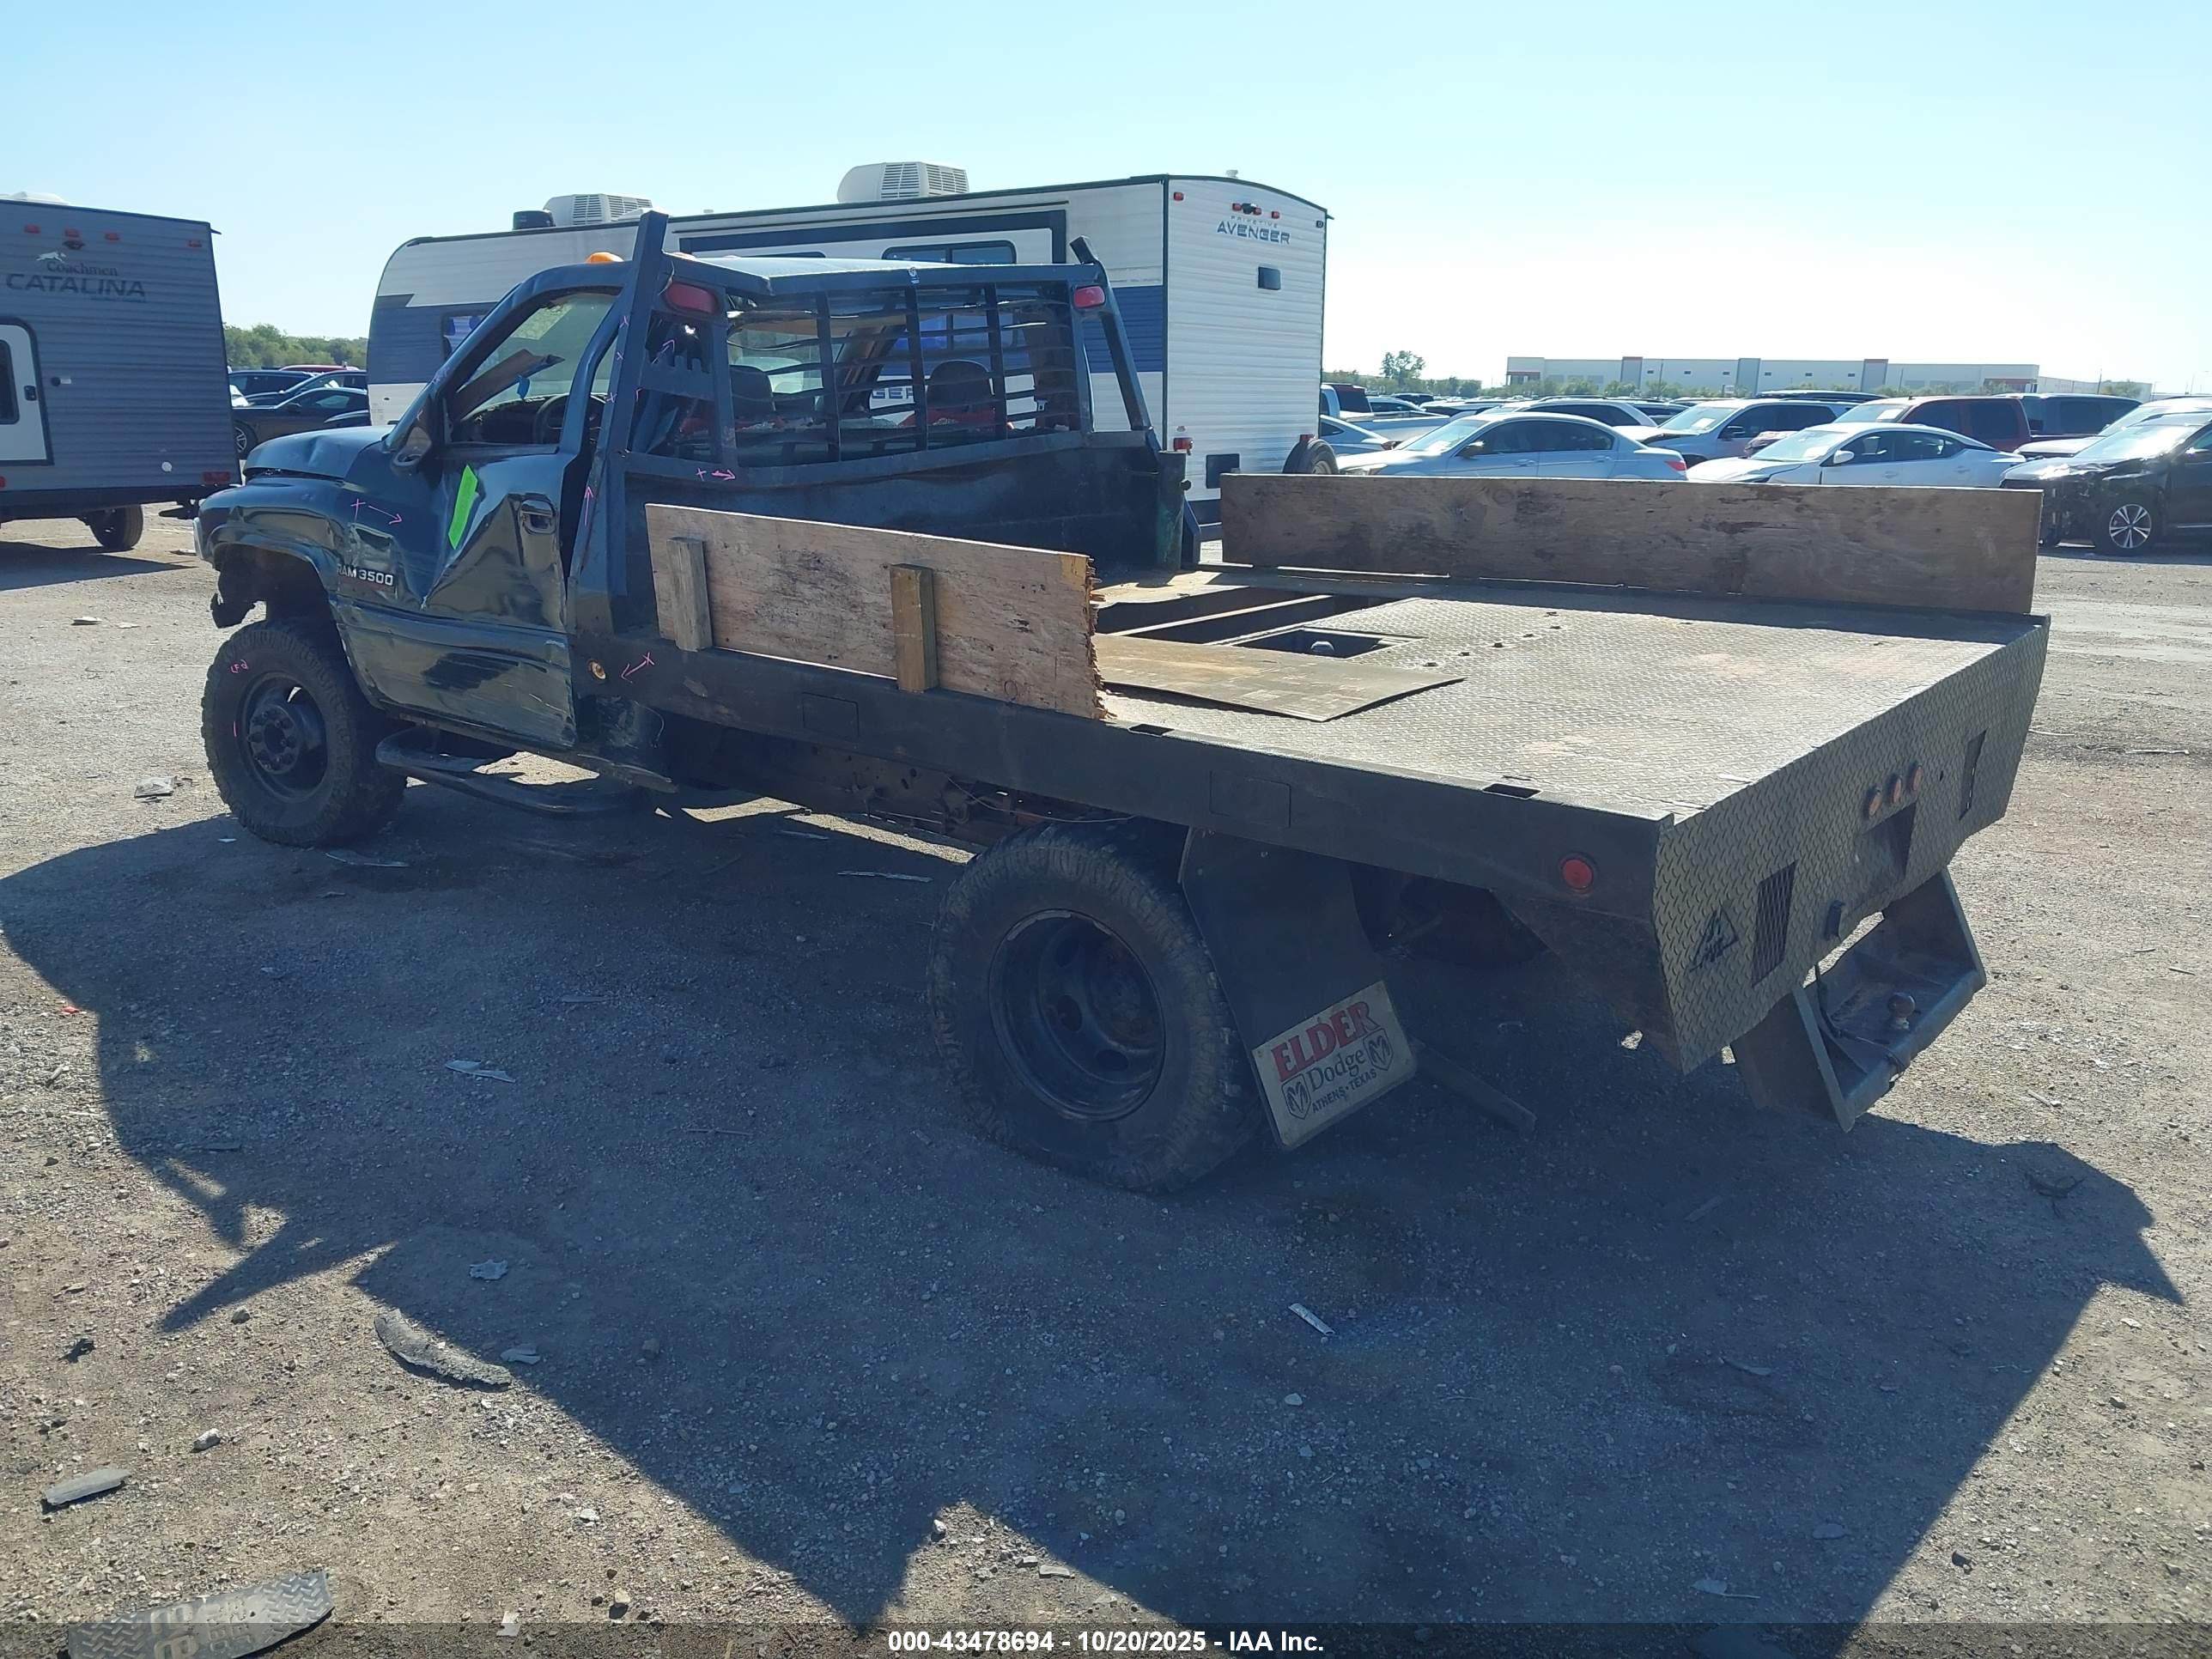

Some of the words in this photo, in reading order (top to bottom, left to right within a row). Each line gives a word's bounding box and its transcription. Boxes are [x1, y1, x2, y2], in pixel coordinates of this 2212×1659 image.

[1217, 221, 1291, 245] AVENGER
[46, 262, 118, 276] Coachmen
[6, 273, 145, 297] CATALINA
[358, 568, 394, 586] 3500
[1271, 1001, 1381, 1082] ELDER
[1306, 1048, 1367, 1092] Dodge
[1311, 1085, 1347, 1114] ATHENS
[1348, 1067, 1377, 1091] TEXAS
